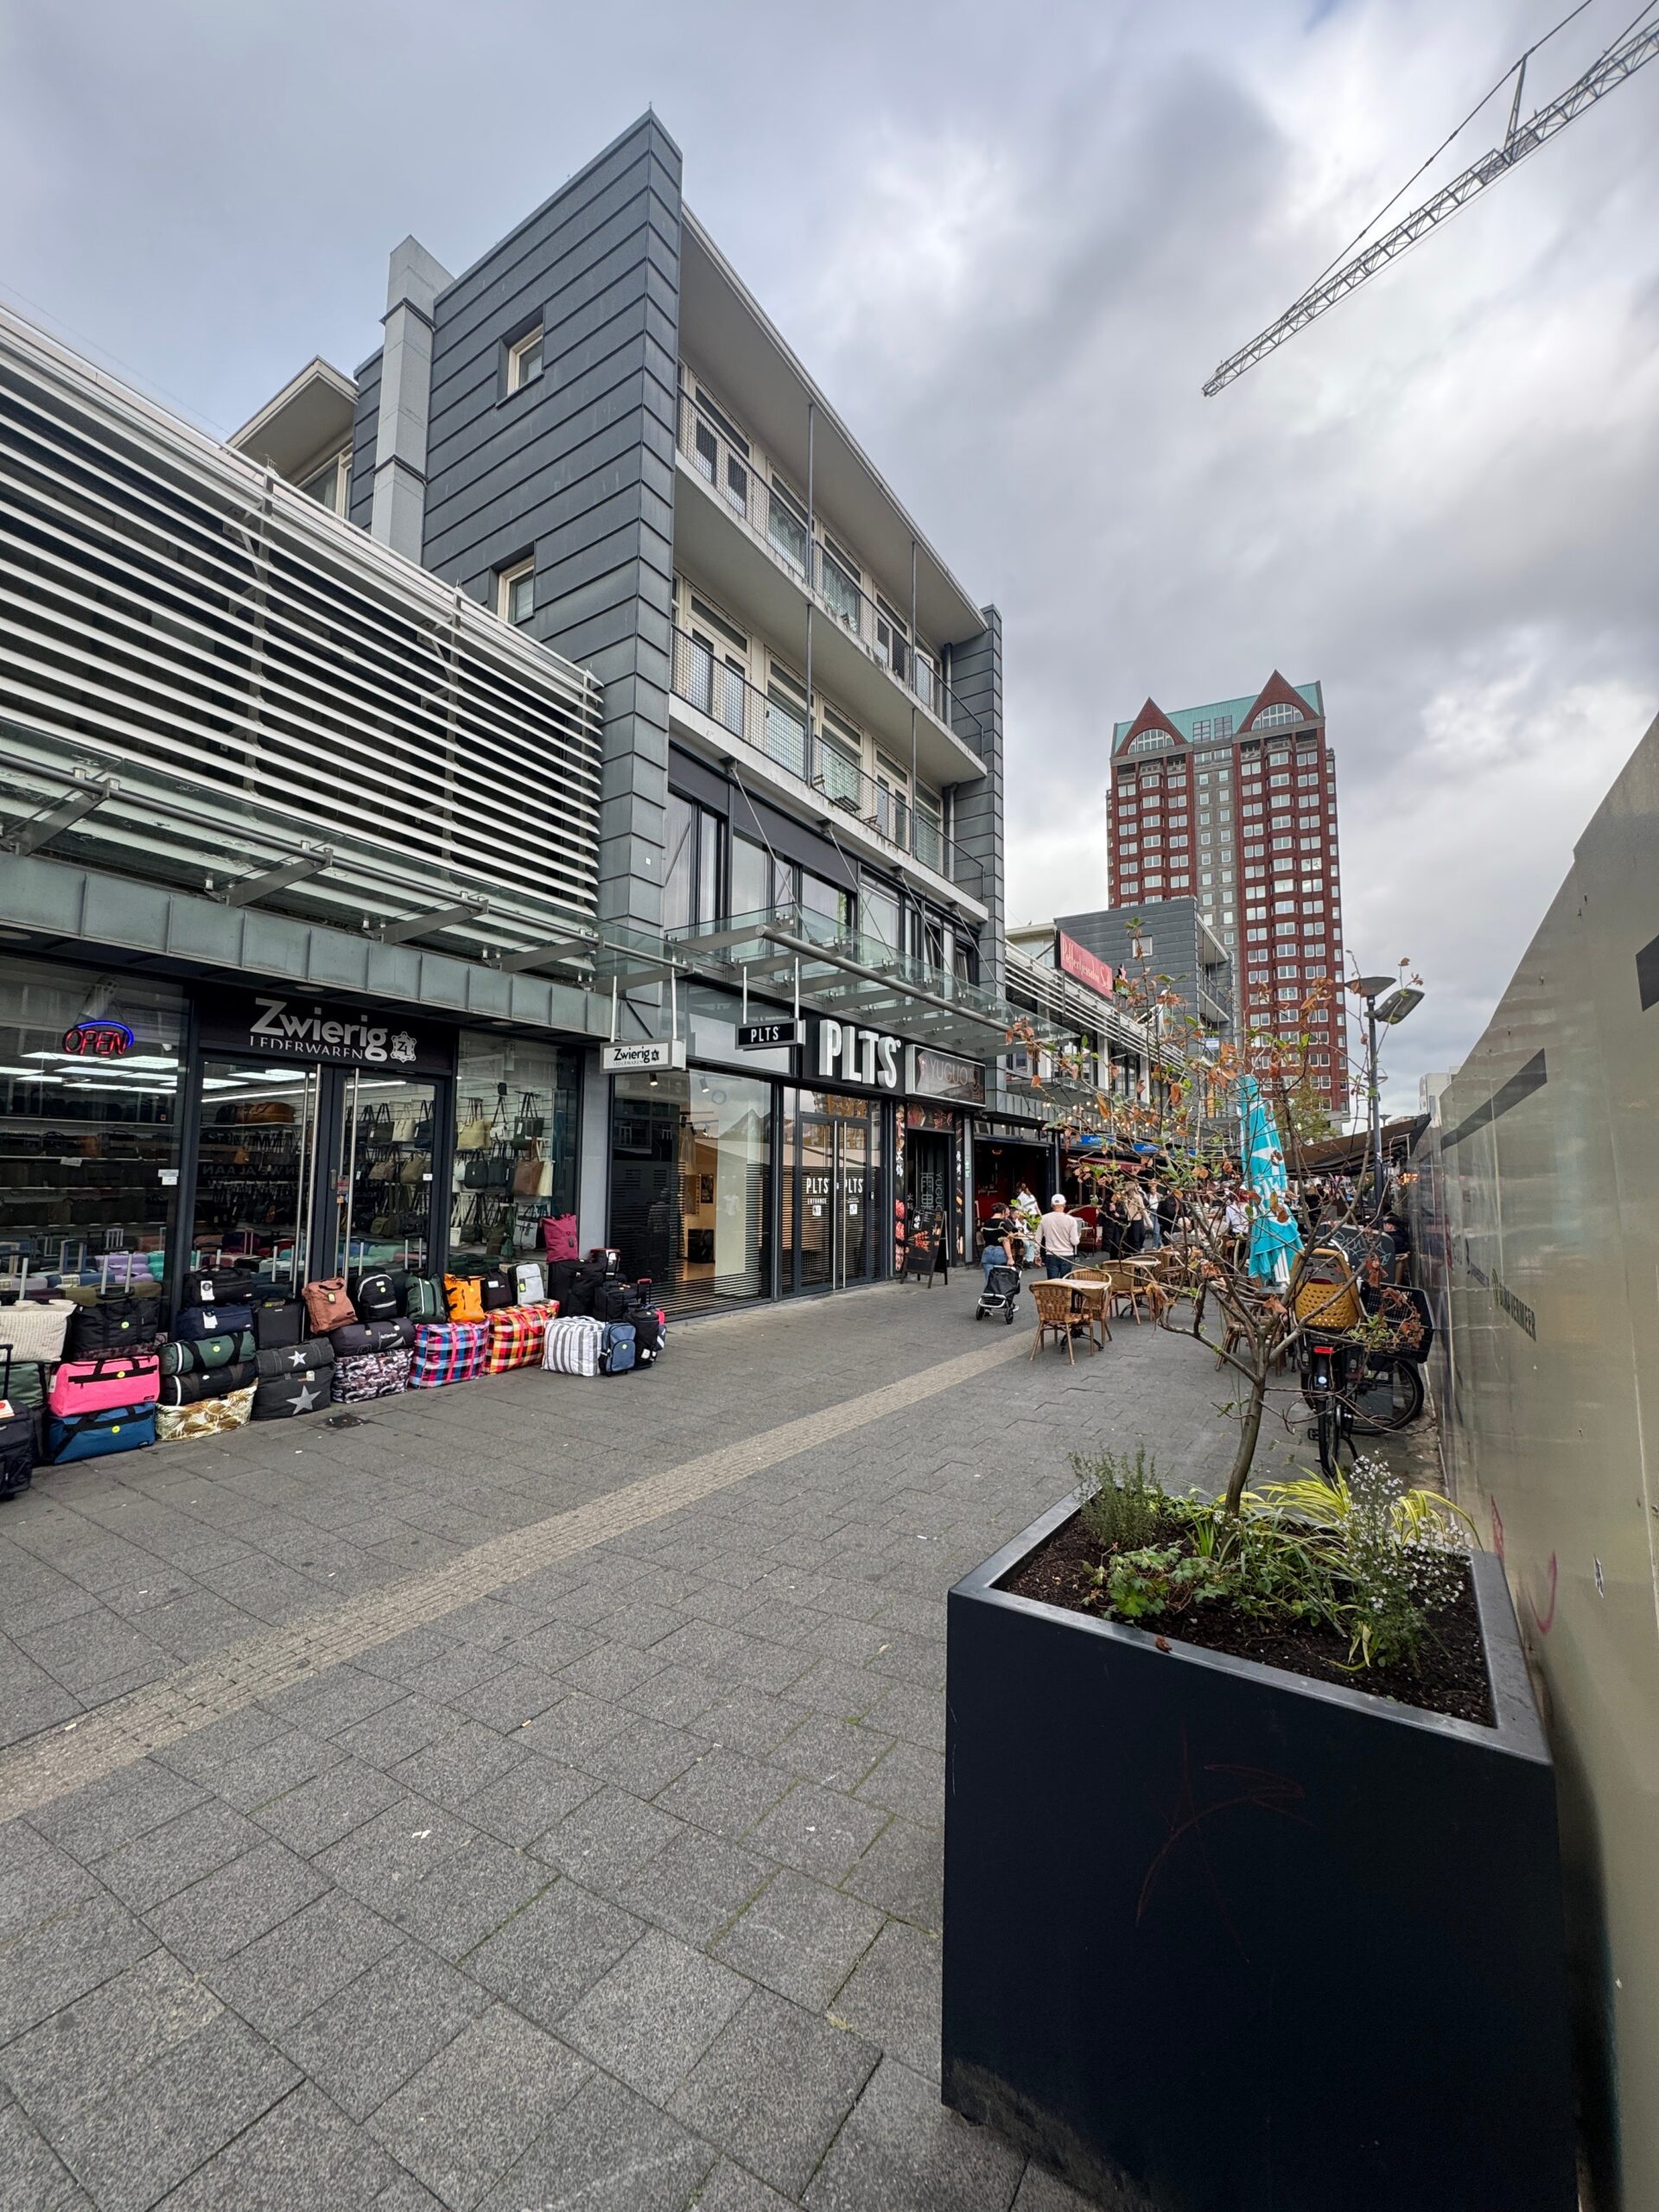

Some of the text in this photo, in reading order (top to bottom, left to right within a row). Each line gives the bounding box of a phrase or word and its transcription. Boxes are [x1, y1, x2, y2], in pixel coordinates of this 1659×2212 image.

[64, 1028, 127, 1056] OPEN
[250, 997, 388, 1062] Zwierig
[613, 1046, 650, 1064] Zwierig
[930, 1058, 968, 1086] YUGUO
